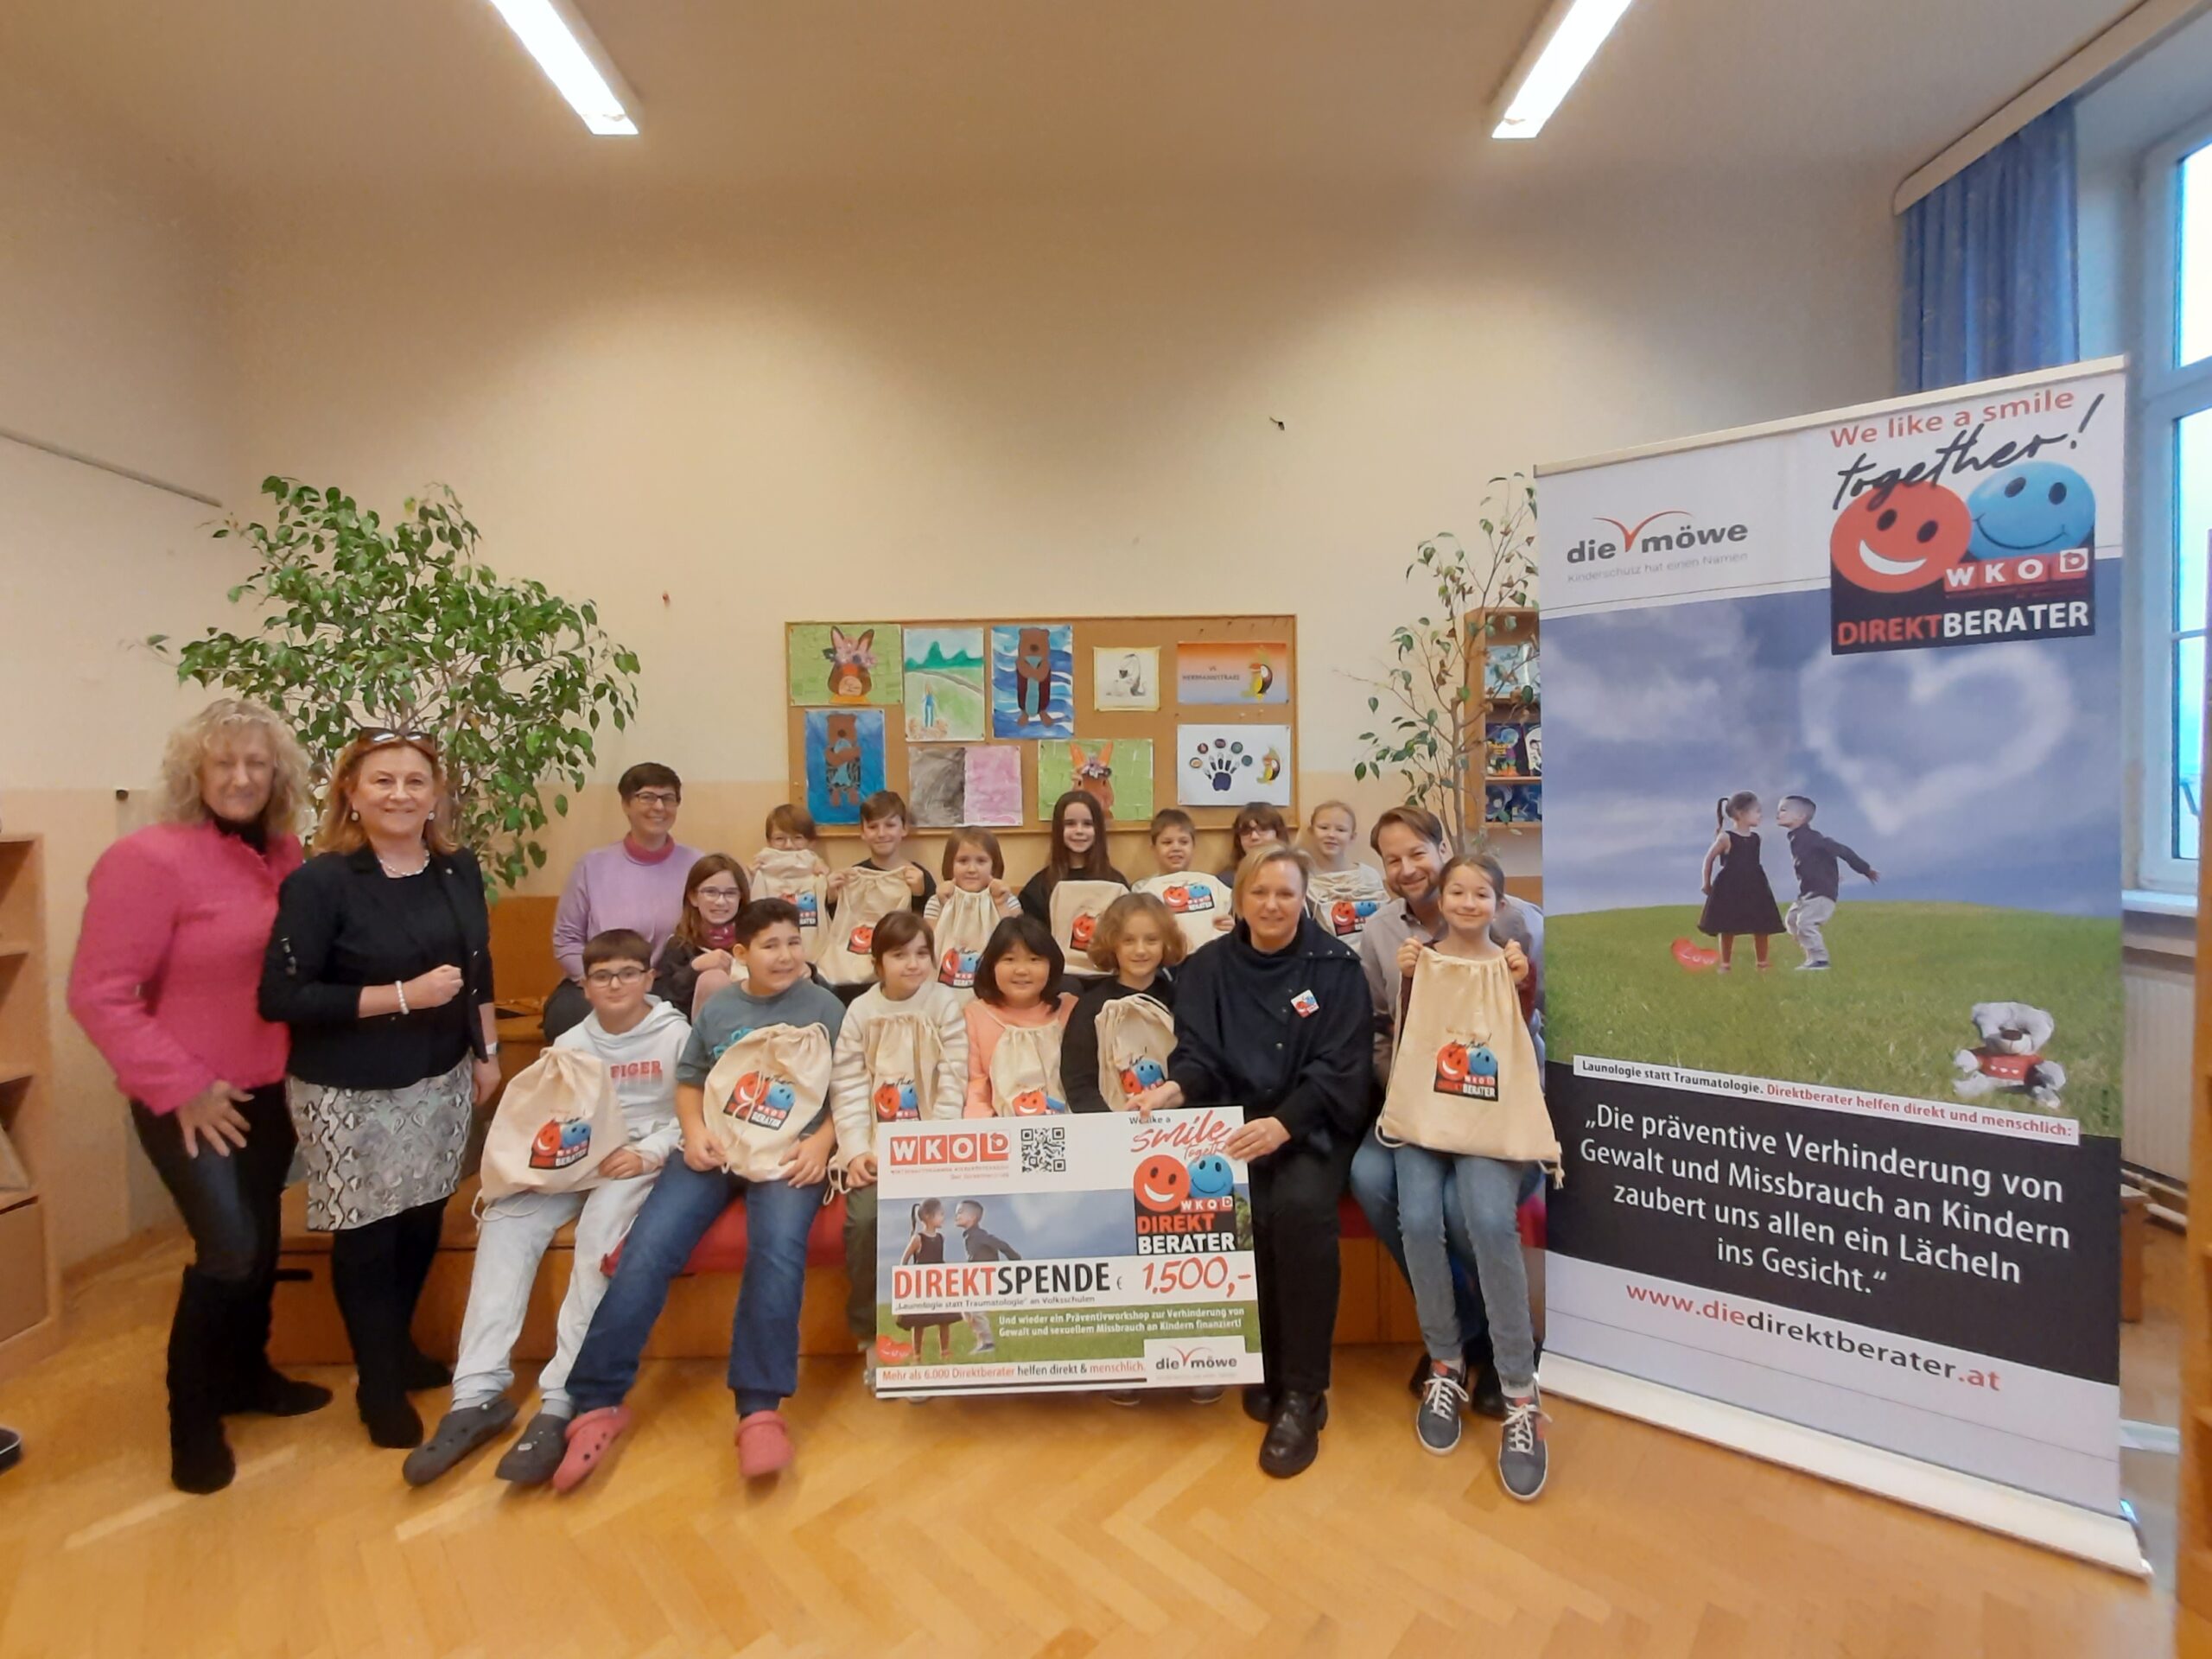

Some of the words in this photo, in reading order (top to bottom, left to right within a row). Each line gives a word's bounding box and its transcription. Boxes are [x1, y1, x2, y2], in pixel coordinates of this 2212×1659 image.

[1830, 425, 1878, 448] We
[1888, 415, 1943, 438] like
[1954, 410, 1971, 427] a
[1983, 390, 2074, 423] smile
[1833, 393, 2105, 512] together!
[1567, 539, 1617, 563] die
[1641, 524, 1749, 553] möwe
[1567, 565, 1641, 583] Kinderschutz
[1644, 563, 1663, 573] hat
[1667, 558, 1700, 570] einen
[1702, 553, 1748, 565] Namen
[1837, 601, 2089, 646] DIREKTBERATER
[1582, 1060, 1642, 1078] Launologie
[1644, 1070, 1670, 1082] statt
[1674, 1072, 1764, 1095] Traumatologie.
[1767, 1084, 1853, 1106] Direktberater
[1857, 1096, 1899, 1113] helfen
[1904, 1102, 1946, 1119] direkt
[1950, 1111, 1977, 1124] und
[1982, 1116, 2072, 1136] menschlich:
[1130, 1109, 1232, 1153] smile
[1585, 1103, 1635, 1132] „Die
[1642, 1115, 1777, 1155] präventive
[1785, 1131, 1991, 1197] Verhinderung
[2002, 1173, 2063, 1203] von
[1580, 1138, 1664, 1174] Gewalt
[1671, 1159, 1719, 1185] und
[1728, 1162, 1884, 1214] Missbrauch
[1894, 1198, 1930, 1224] an
[1942, 1199, 2070, 1249] Kindern
[1137, 1213, 1215, 1234] DIREKT
[1138, 1232, 1236, 1255] BERATER
[1613, 1185, 1707, 1220] zaubert
[1714, 1204, 1760, 1230] uns
[1768, 1211, 1834, 1245] allen
[1844, 1227, 1889, 1257] ein
[1900, 1234, 2021, 1284] Lächeln
[894, 1262, 1110, 1300] DIREKTSPENDE
[1717, 1237, 1754, 1267] ins
[1762, 1248, 1887, 1294] Gesicht.“
[999, 1315, 1016, 1325] Und
[1018, 1314, 1048, 1325] wieder
[1050, 1313, 1064, 1323] ein
[1065, 1309, 1149, 1323] Präventivworkshop
[1151, 1311, 1165, 1319] zur
[1166, 1307, 1226, 1319] Verhinderung
[1228, 1307, 1244, 1316] von
[1041, 1295, 1096, 1304] Volksschulen
[999, 1327, 1029, 1337] Gewalt
[1032, 1325, 1049, 1336] und
[1050, 1325, 1095, 1335] sexuellem
[1096, 1322, 1146, 1333] Missbrauch
[1160, 1321, 1194, 1331] Kindern
[1626, 1283, 2001, 1391] www.diedirektberater.at
[882, 1370, 906, 1381] Mehr
[909, 1369, 921, 1380] als
[924, 1368, 950, 1380] 6.000
[951, 1365, 1014, 1379] Direktberater
[1017, 1364, 1046, 1376] helfen
[1050, 1363, 1078, 1376] direkt
[1080, 1363, 1087, 1374] &
[1156, 1357, 1179, 1370] die
[1191, 1356, 1237, 1369] möwe
